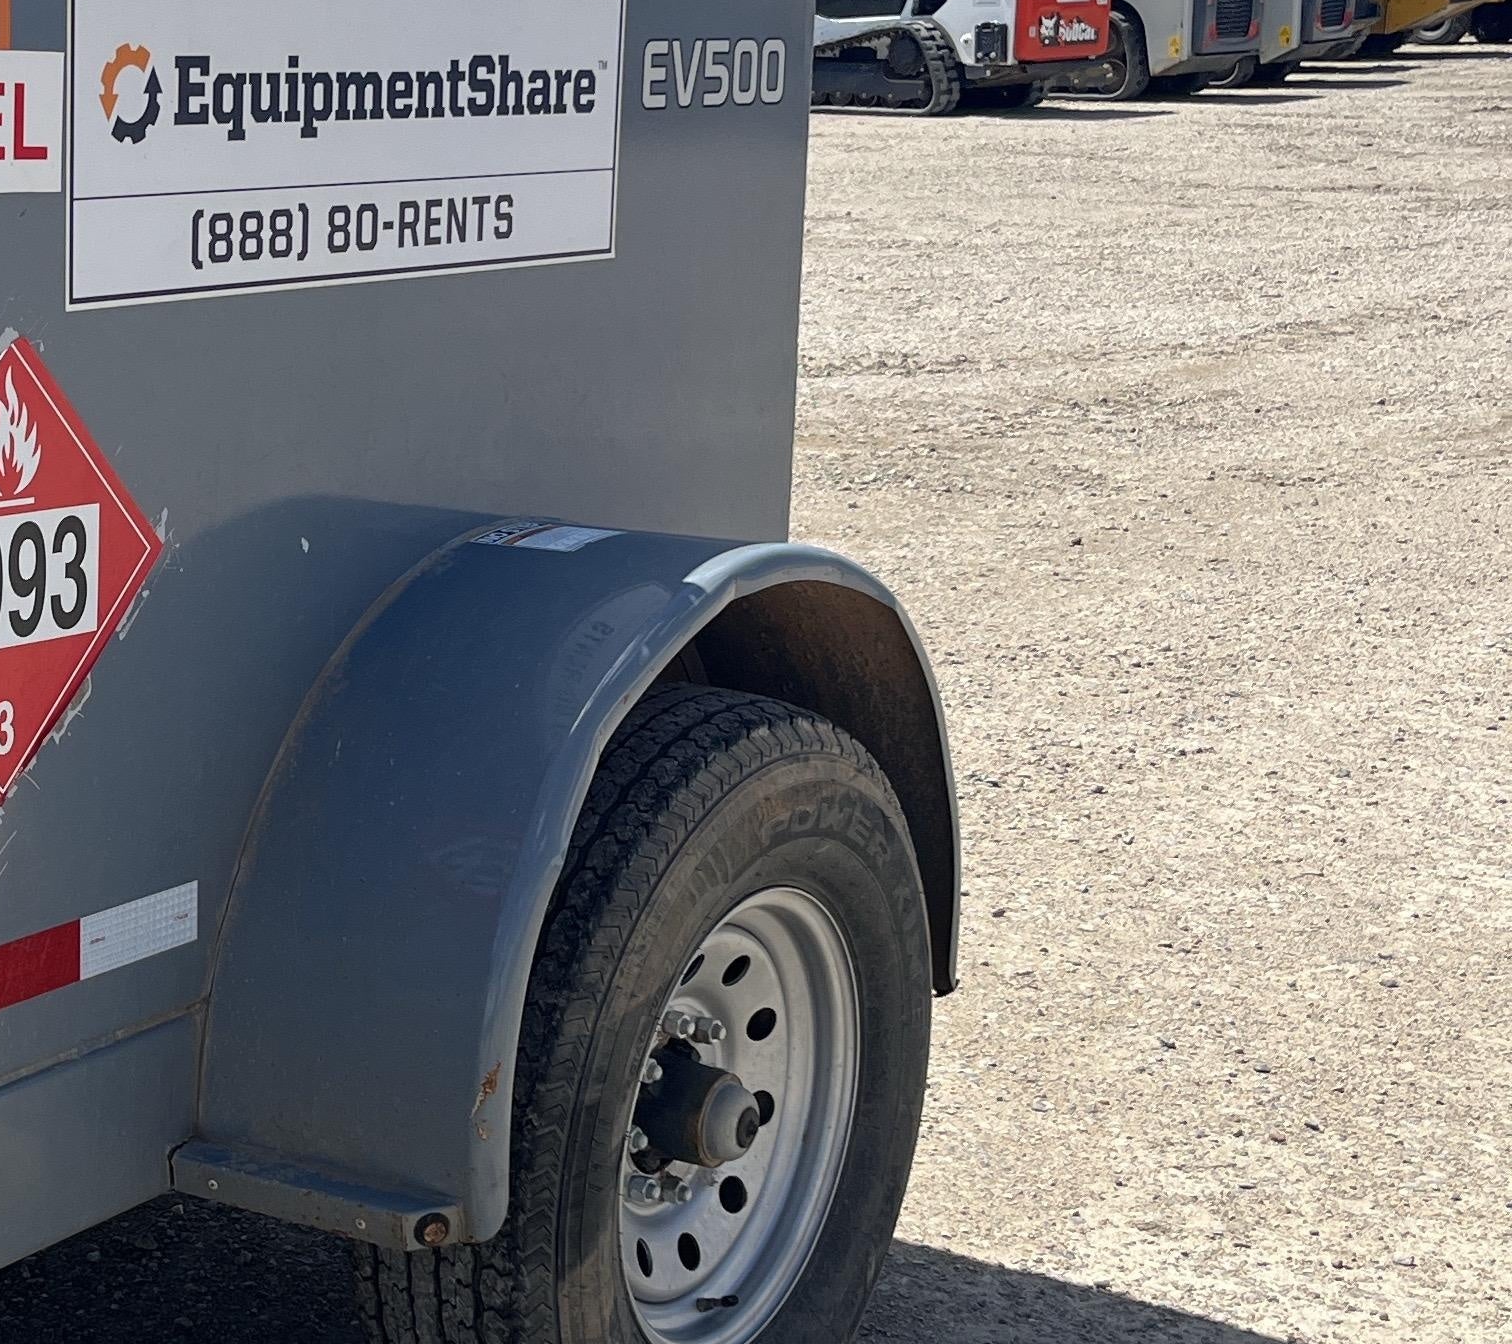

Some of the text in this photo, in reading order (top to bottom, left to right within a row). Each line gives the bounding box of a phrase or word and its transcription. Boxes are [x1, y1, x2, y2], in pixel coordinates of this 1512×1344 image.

[174, 54, 596, 141] EquipmentShare
[641, 38, 786, 110] EV500
[192, 194, 514, 269] (888) 80-RENTS
